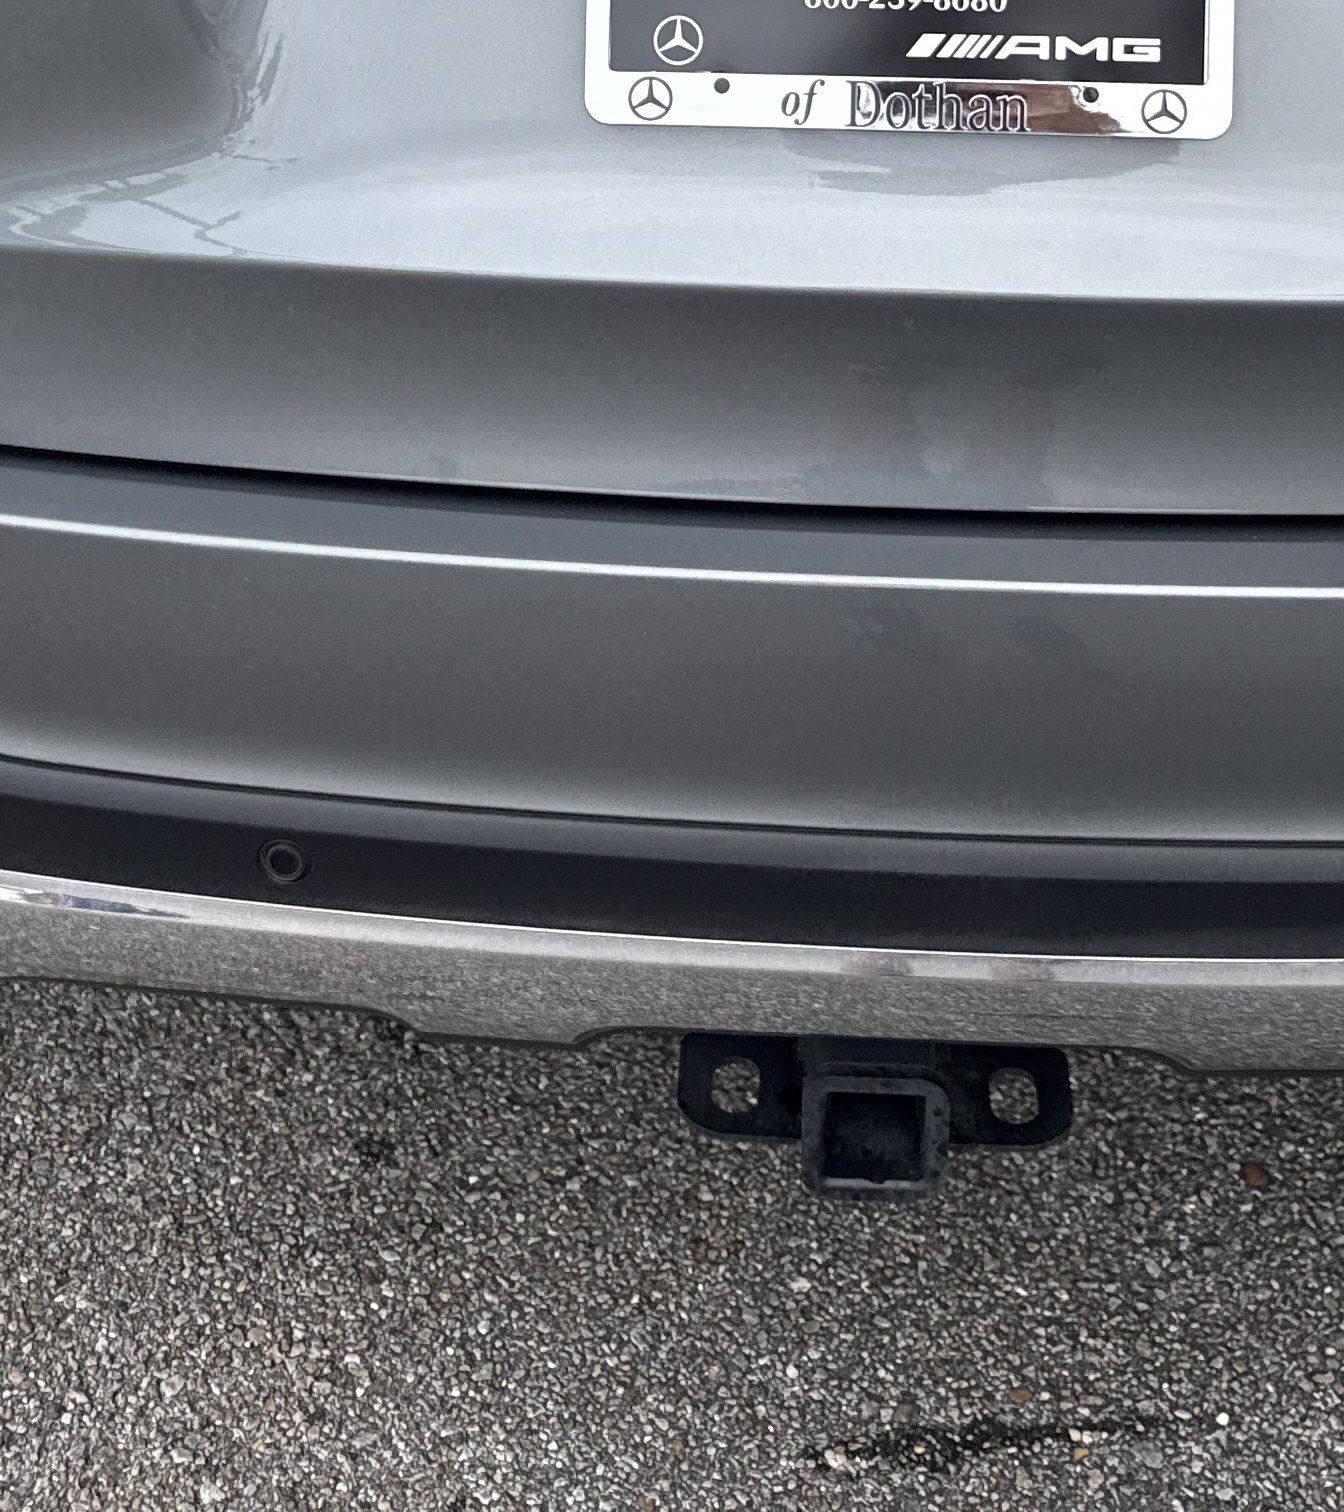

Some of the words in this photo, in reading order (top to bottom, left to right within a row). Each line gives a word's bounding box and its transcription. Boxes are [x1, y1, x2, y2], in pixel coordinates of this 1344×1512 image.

[994, 35, 1161, 64] AMG
[780, 78, 826, 126] of
[845, 79, 1032, 133] Dothan
